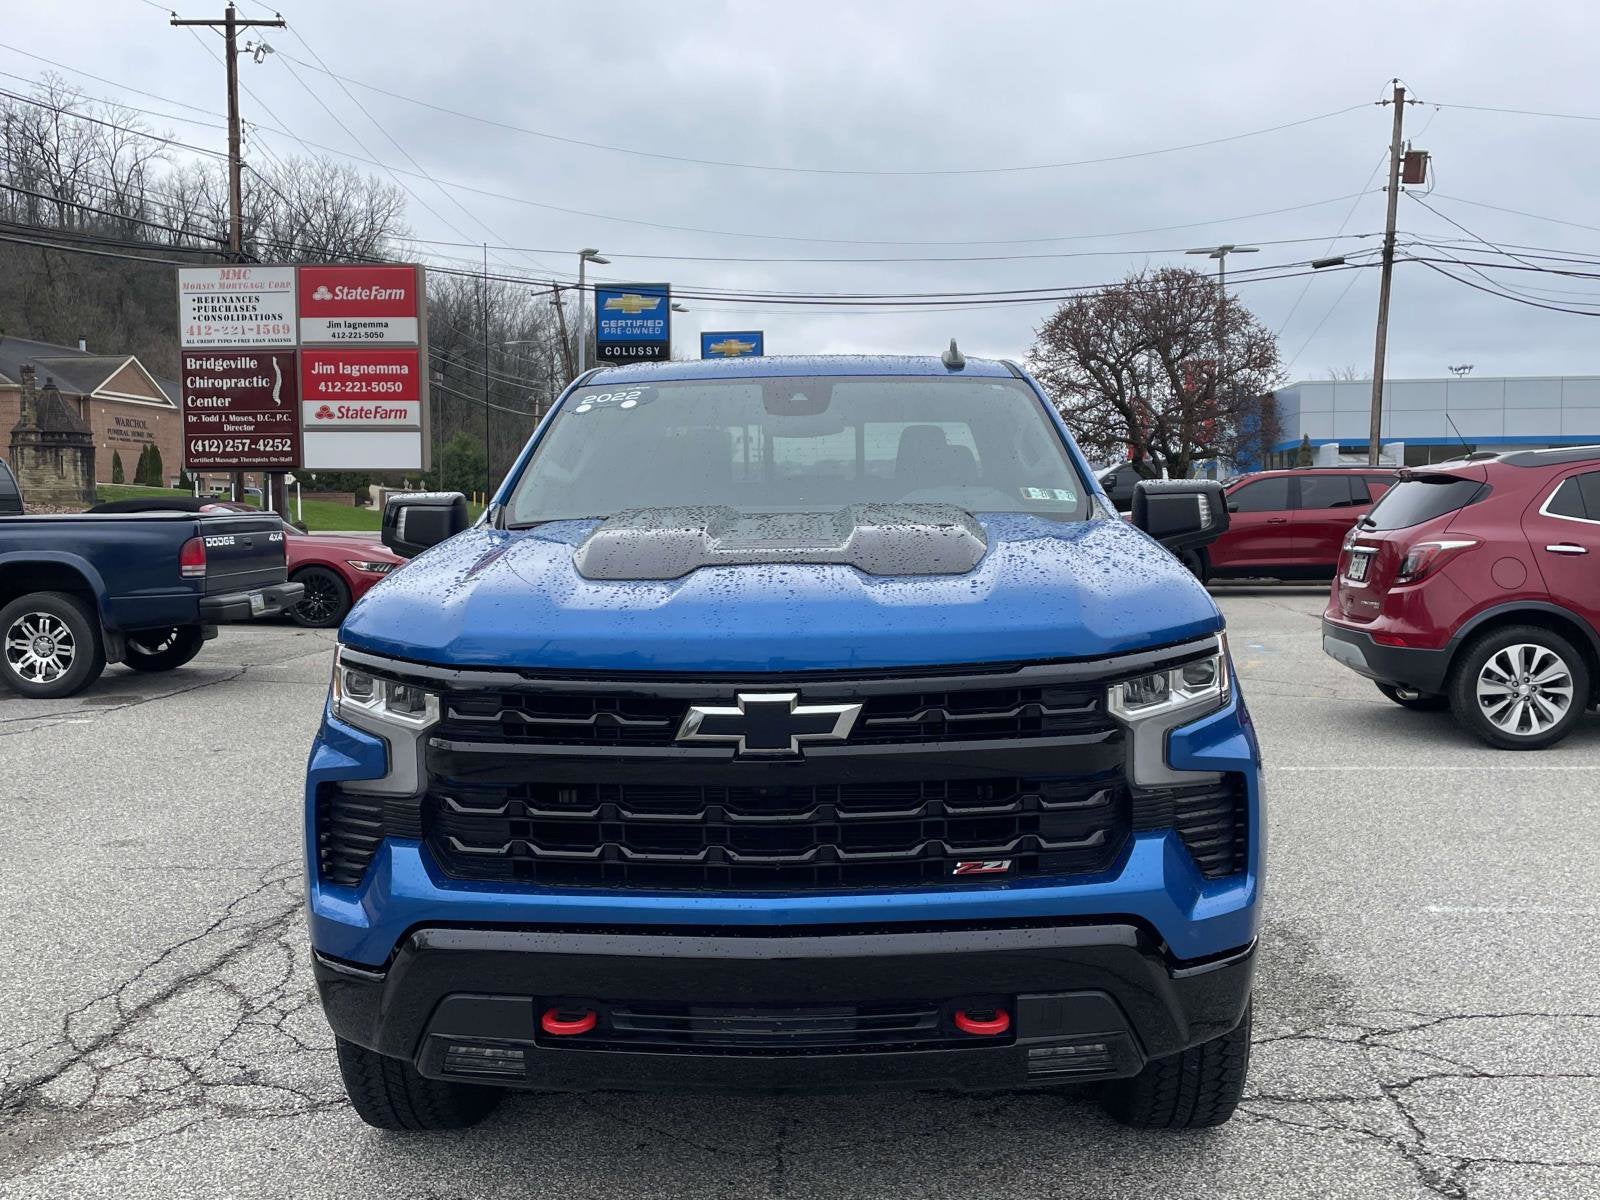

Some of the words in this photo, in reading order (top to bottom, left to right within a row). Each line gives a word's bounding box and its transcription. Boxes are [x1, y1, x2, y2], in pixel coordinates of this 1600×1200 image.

[220, 269, 252, 281] MMC
[218, 281, 265, 290] MORTGAGE
[196, 295, 260, 304] REFINANCES
[197, 304, 257, 313] PURCHASES
[197, 313, 283, 322] CONSOLIDATIONS
[326, 320, 341, 329] Jim
[344, 320, 389, 330] Iagnemma
[601, 319, 664, 328] CERTIFIED
[186, 323, 291, 336] 412-221-1569
[604, 327, 661, 335] PRE-OWNED
[331, 331, 385, 339] 412-221-5050
[605, 346, 660, 356] COLUSSY
[186, 357, 258, 372] Bridgeville
[311, 361, 335, 375] Jim
[339, 361, 409, 377] Iagnemma
[186, 375, 271, 390] Chiropractic
[318, 381, 403, 393] 412-221-5050
[187, 395, 232, 407] Center
[580, 391, 641, 405] 2022
[114, 416, 148, 429] WARCHOL
[188, 415, 200, 423] Dr.
[201, 414, 219, 422] Todd
[223, 424, 255, 432] Director
[205, 536, 235, 547] DODGE
[952, 860, 1012, 875] Z71
